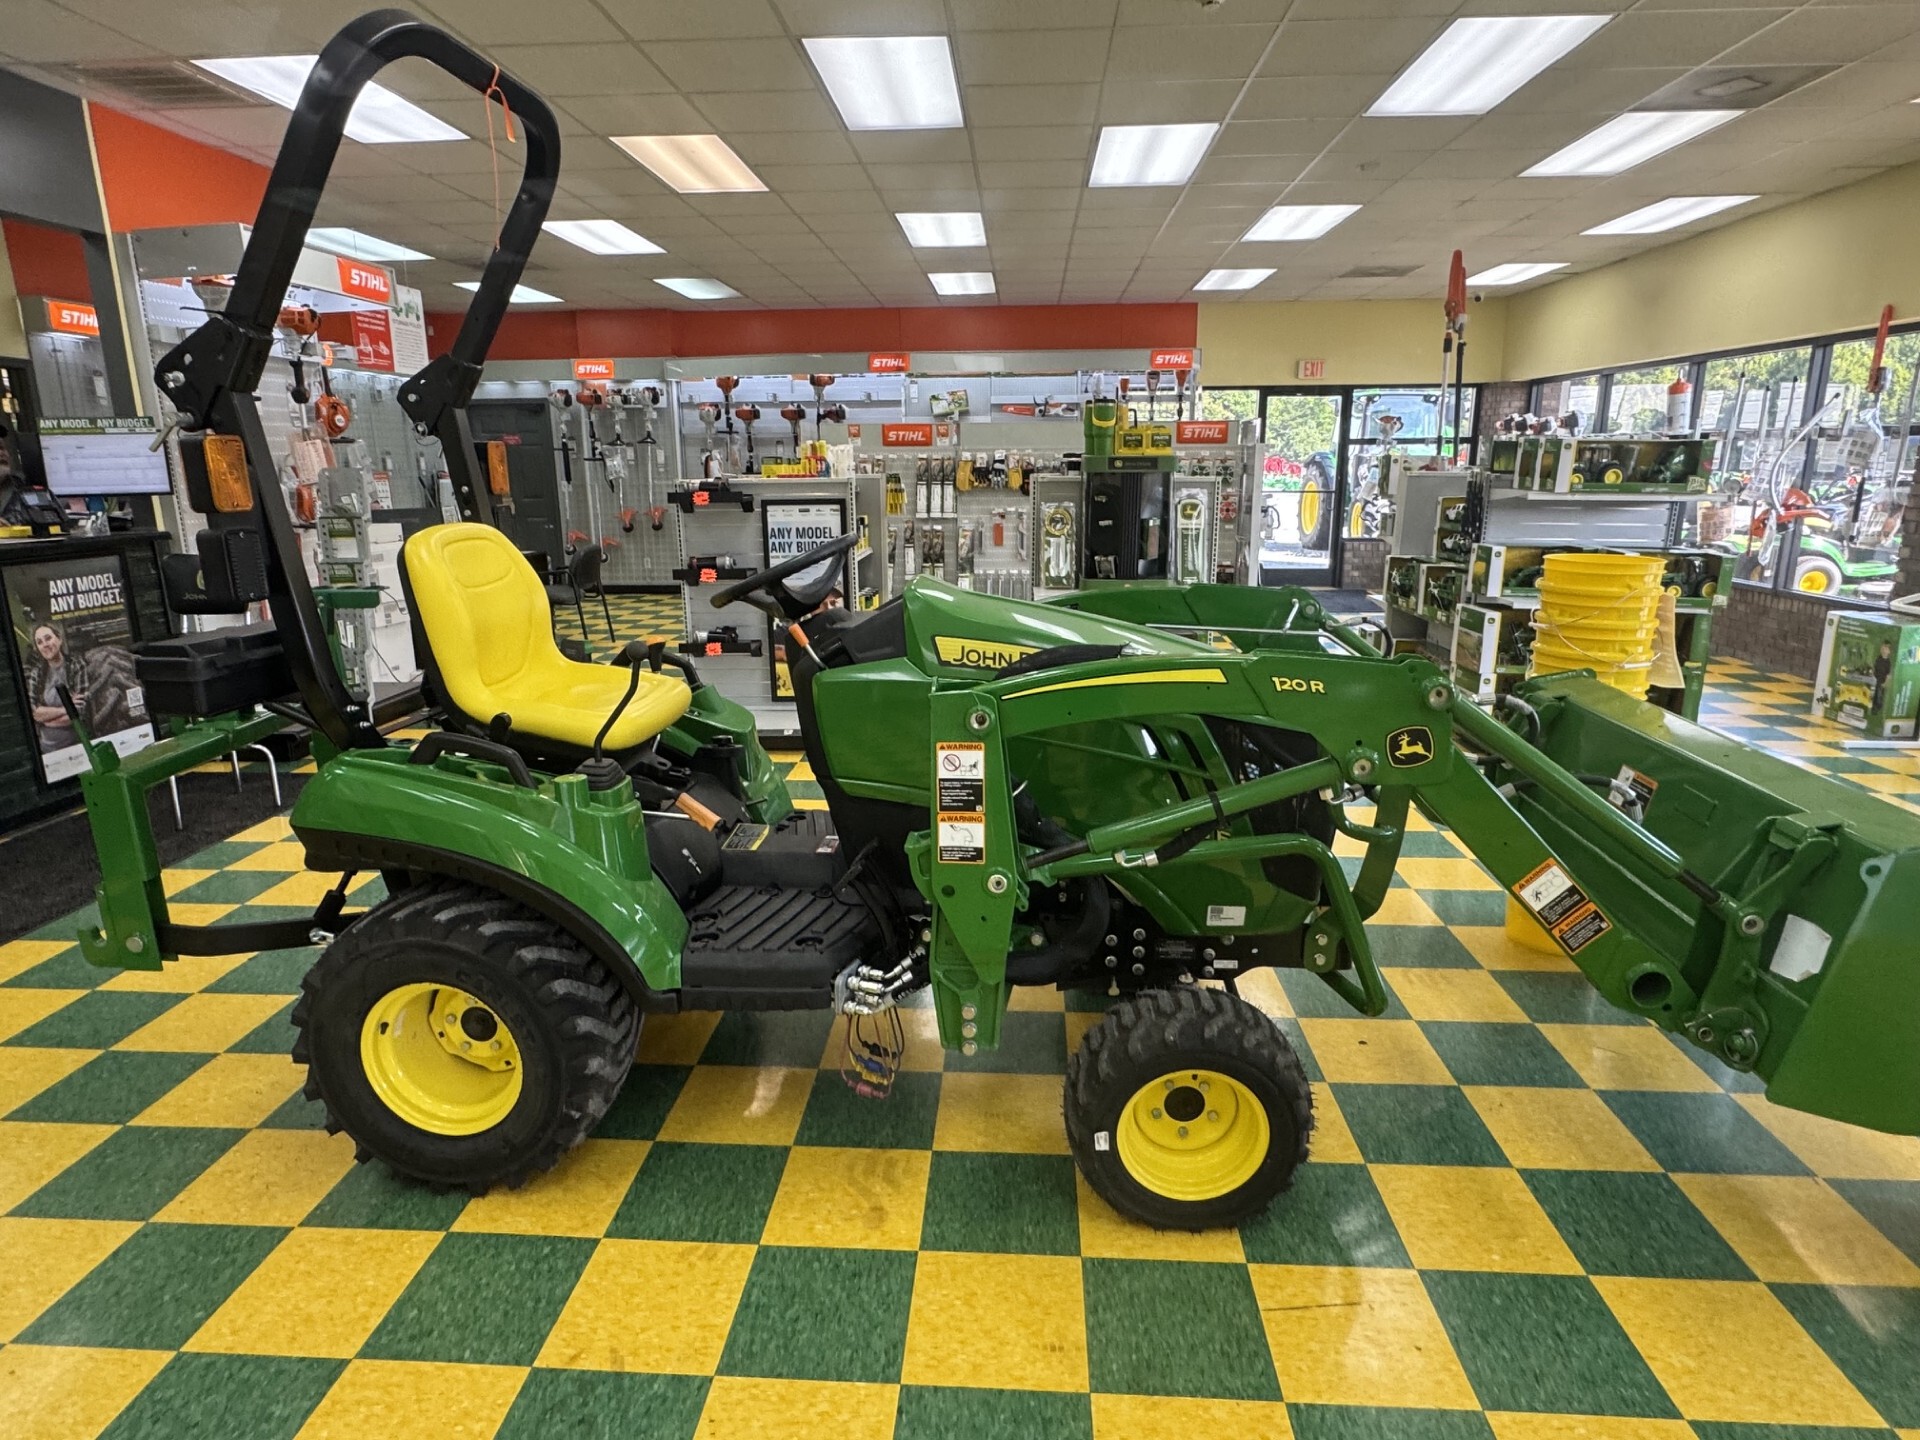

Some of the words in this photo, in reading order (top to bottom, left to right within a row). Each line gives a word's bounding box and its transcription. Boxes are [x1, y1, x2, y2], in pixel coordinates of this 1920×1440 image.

[350, 268, 388, 292] STIHL
[873, 358, 906, 368] STIHL
[1155, 354, 1189, 364] STIHL
[577, 364, 610, 374] STIHL
[1303, 361, 1325, 377] EXIT
[40, 419, 58, 429] ANY
[60, 419, 95, 429] MODEL.
[97, 418, 115, 428] ANY
[887, 430, 926, 441] STIHL
[1183, 428, 1223, 438] STIHL
[769, 527, 792, 540] ANY
[795, 526, 839, 540] MODEL.
[770, 541, 793, 554] ANY
[49, 578, 74, 596] ANY
[75, 572, 122, 593] MODEL.
[50, 594, 75, 614] ANY
[77, 588, 125, 610] BUDGET.
[952, 645, 1013, 667] JOHN
[946, 815, 983, 823] WARNING
[1525, 862, 1551, 885] WARNING
[1564, 907, 1592, 928] WARNING
